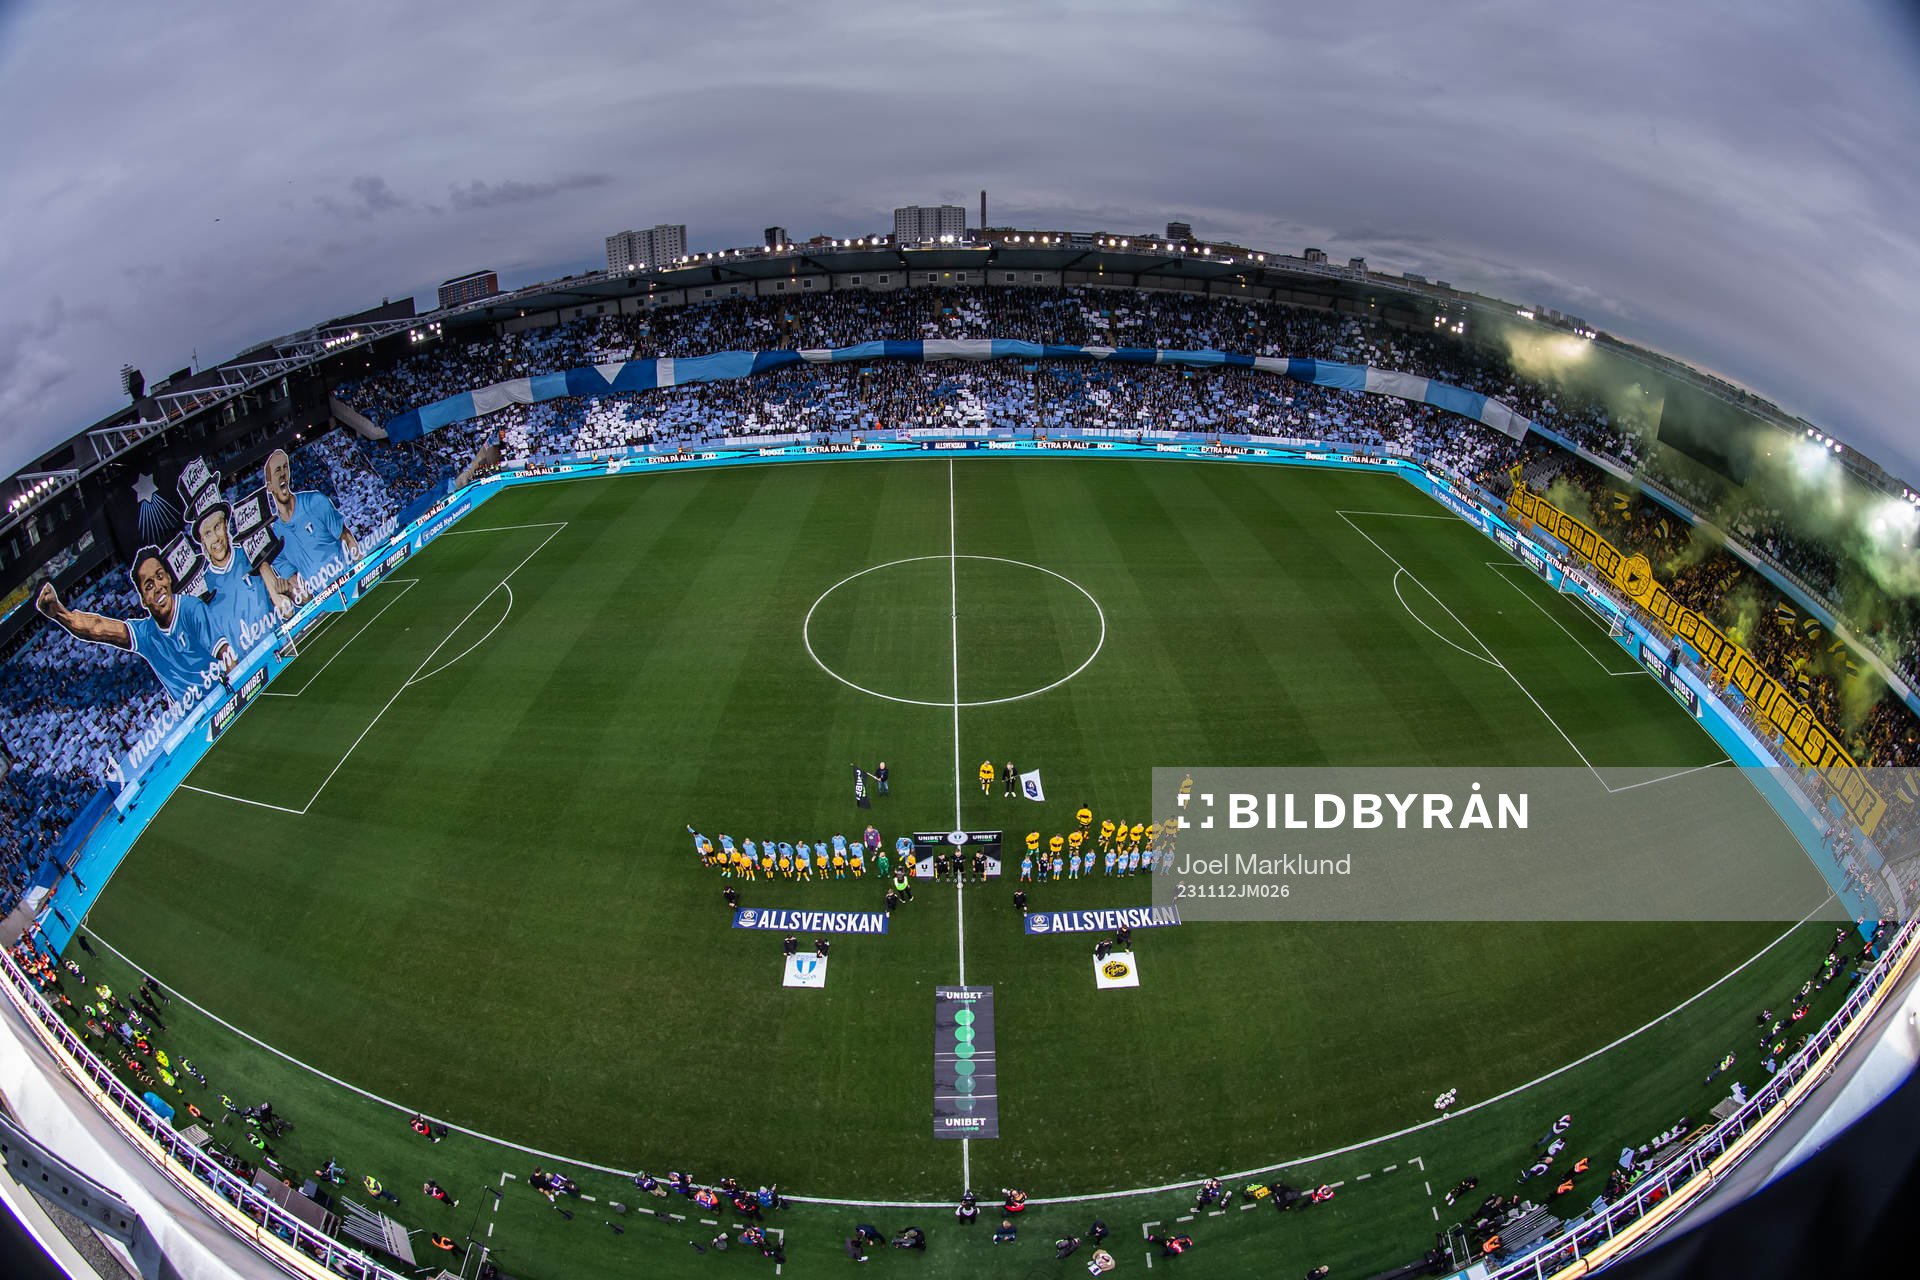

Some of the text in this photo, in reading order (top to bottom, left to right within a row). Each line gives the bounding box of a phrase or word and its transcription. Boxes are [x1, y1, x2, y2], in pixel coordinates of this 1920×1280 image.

[806, 445, 830, 454] EXTRA
[841, 444, 859, 452] ALLT
[1037, 441, 1061, 449] EXTRA
[1200, 446, 1222, 454] EXTRA
[1233, 447, 1249, 455] ALLT
[648, 455, 669, 464] EXTRA
[680, 453, 695, 461] ALLT
[1342, 455, 1361, 463] EXTRA
[515, 470, 534, 478] EXTRA
[1495, 528, 1518, 550] UNIBET
[386, 545, 408, 567] UNIBET
[1520, 546, 1544, 570] UNIBET
[360, 563, 384, 588] UNIBET
[1558, 515, 1597, 560] SKA
[1596, 541, 1621, 579] SE
[1769, 692, 1877, 826] MÄSTARE
[1642, 645, 1667, 677] UNIBET
[240, 667, 265, 699] UNIBET
[1669, 671, 1695, 703] UNIBET
[213, 694, 239, 727] UNIBET
[757, 910, 883, 932] ALLSVENSKAN
[1052, 906, 1176, 932] ALLSVENSKAN
[946, 991, 983, 999] UNIBET
[945, 1117, 987, 1126] UNIBET
